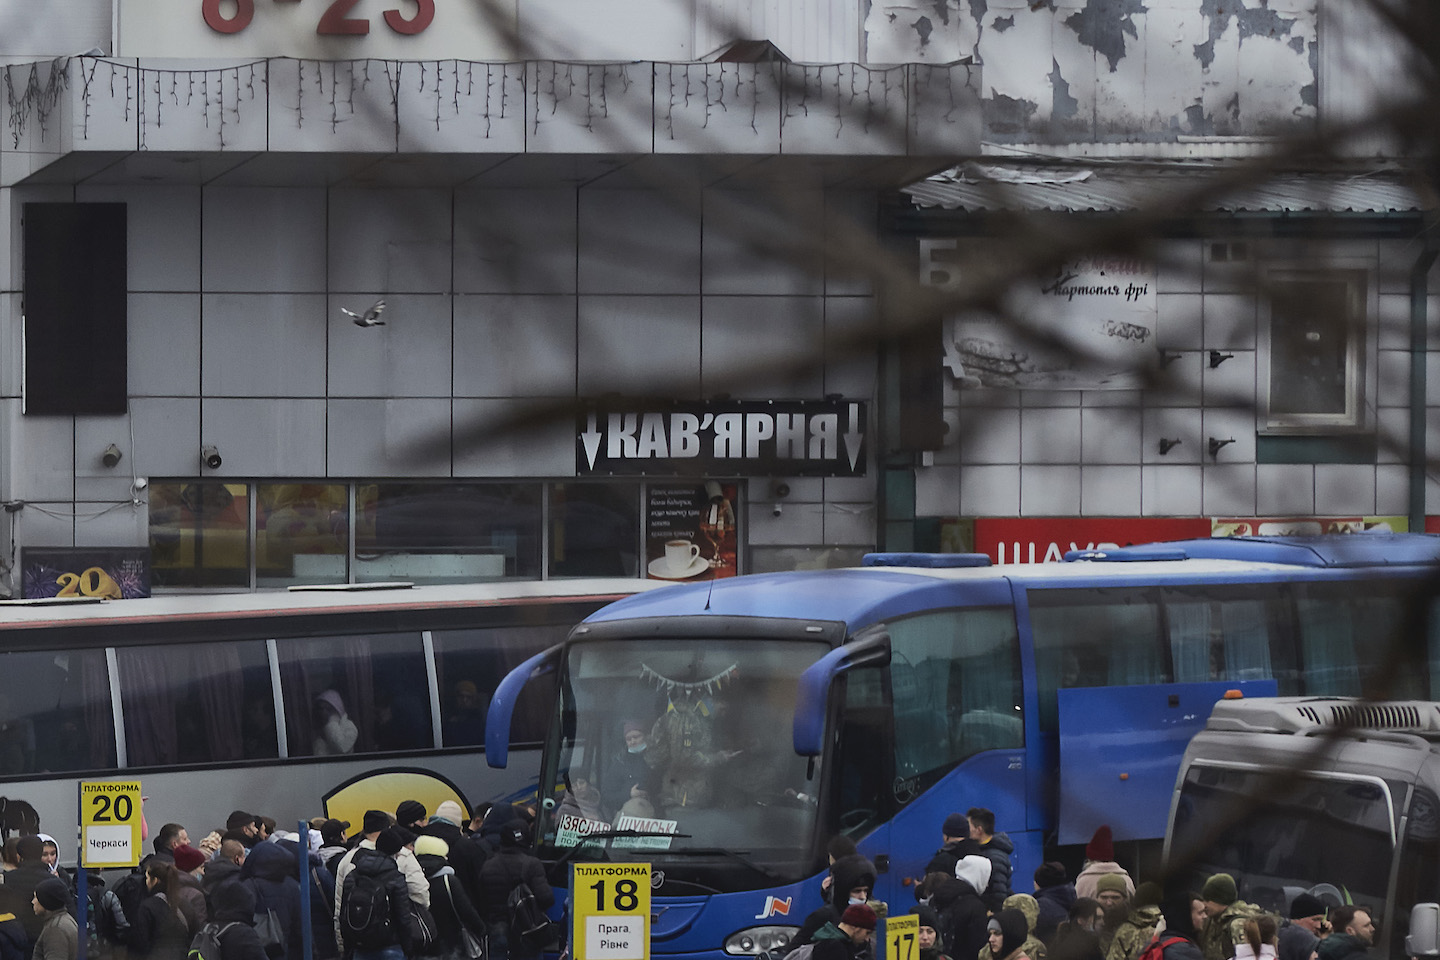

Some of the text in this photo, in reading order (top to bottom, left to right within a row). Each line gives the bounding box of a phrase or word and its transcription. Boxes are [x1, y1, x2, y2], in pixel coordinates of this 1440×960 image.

[1124, 283, 1148, 301] фрі
[92, 794, 133, 822] 20
[90, 839, 128, 849] Черкаси
[577, 868, 648, 876] ПЛАТФОРМА
[590, 879, 639, 912] 18
[600, 940, 629, 949] Рівне
